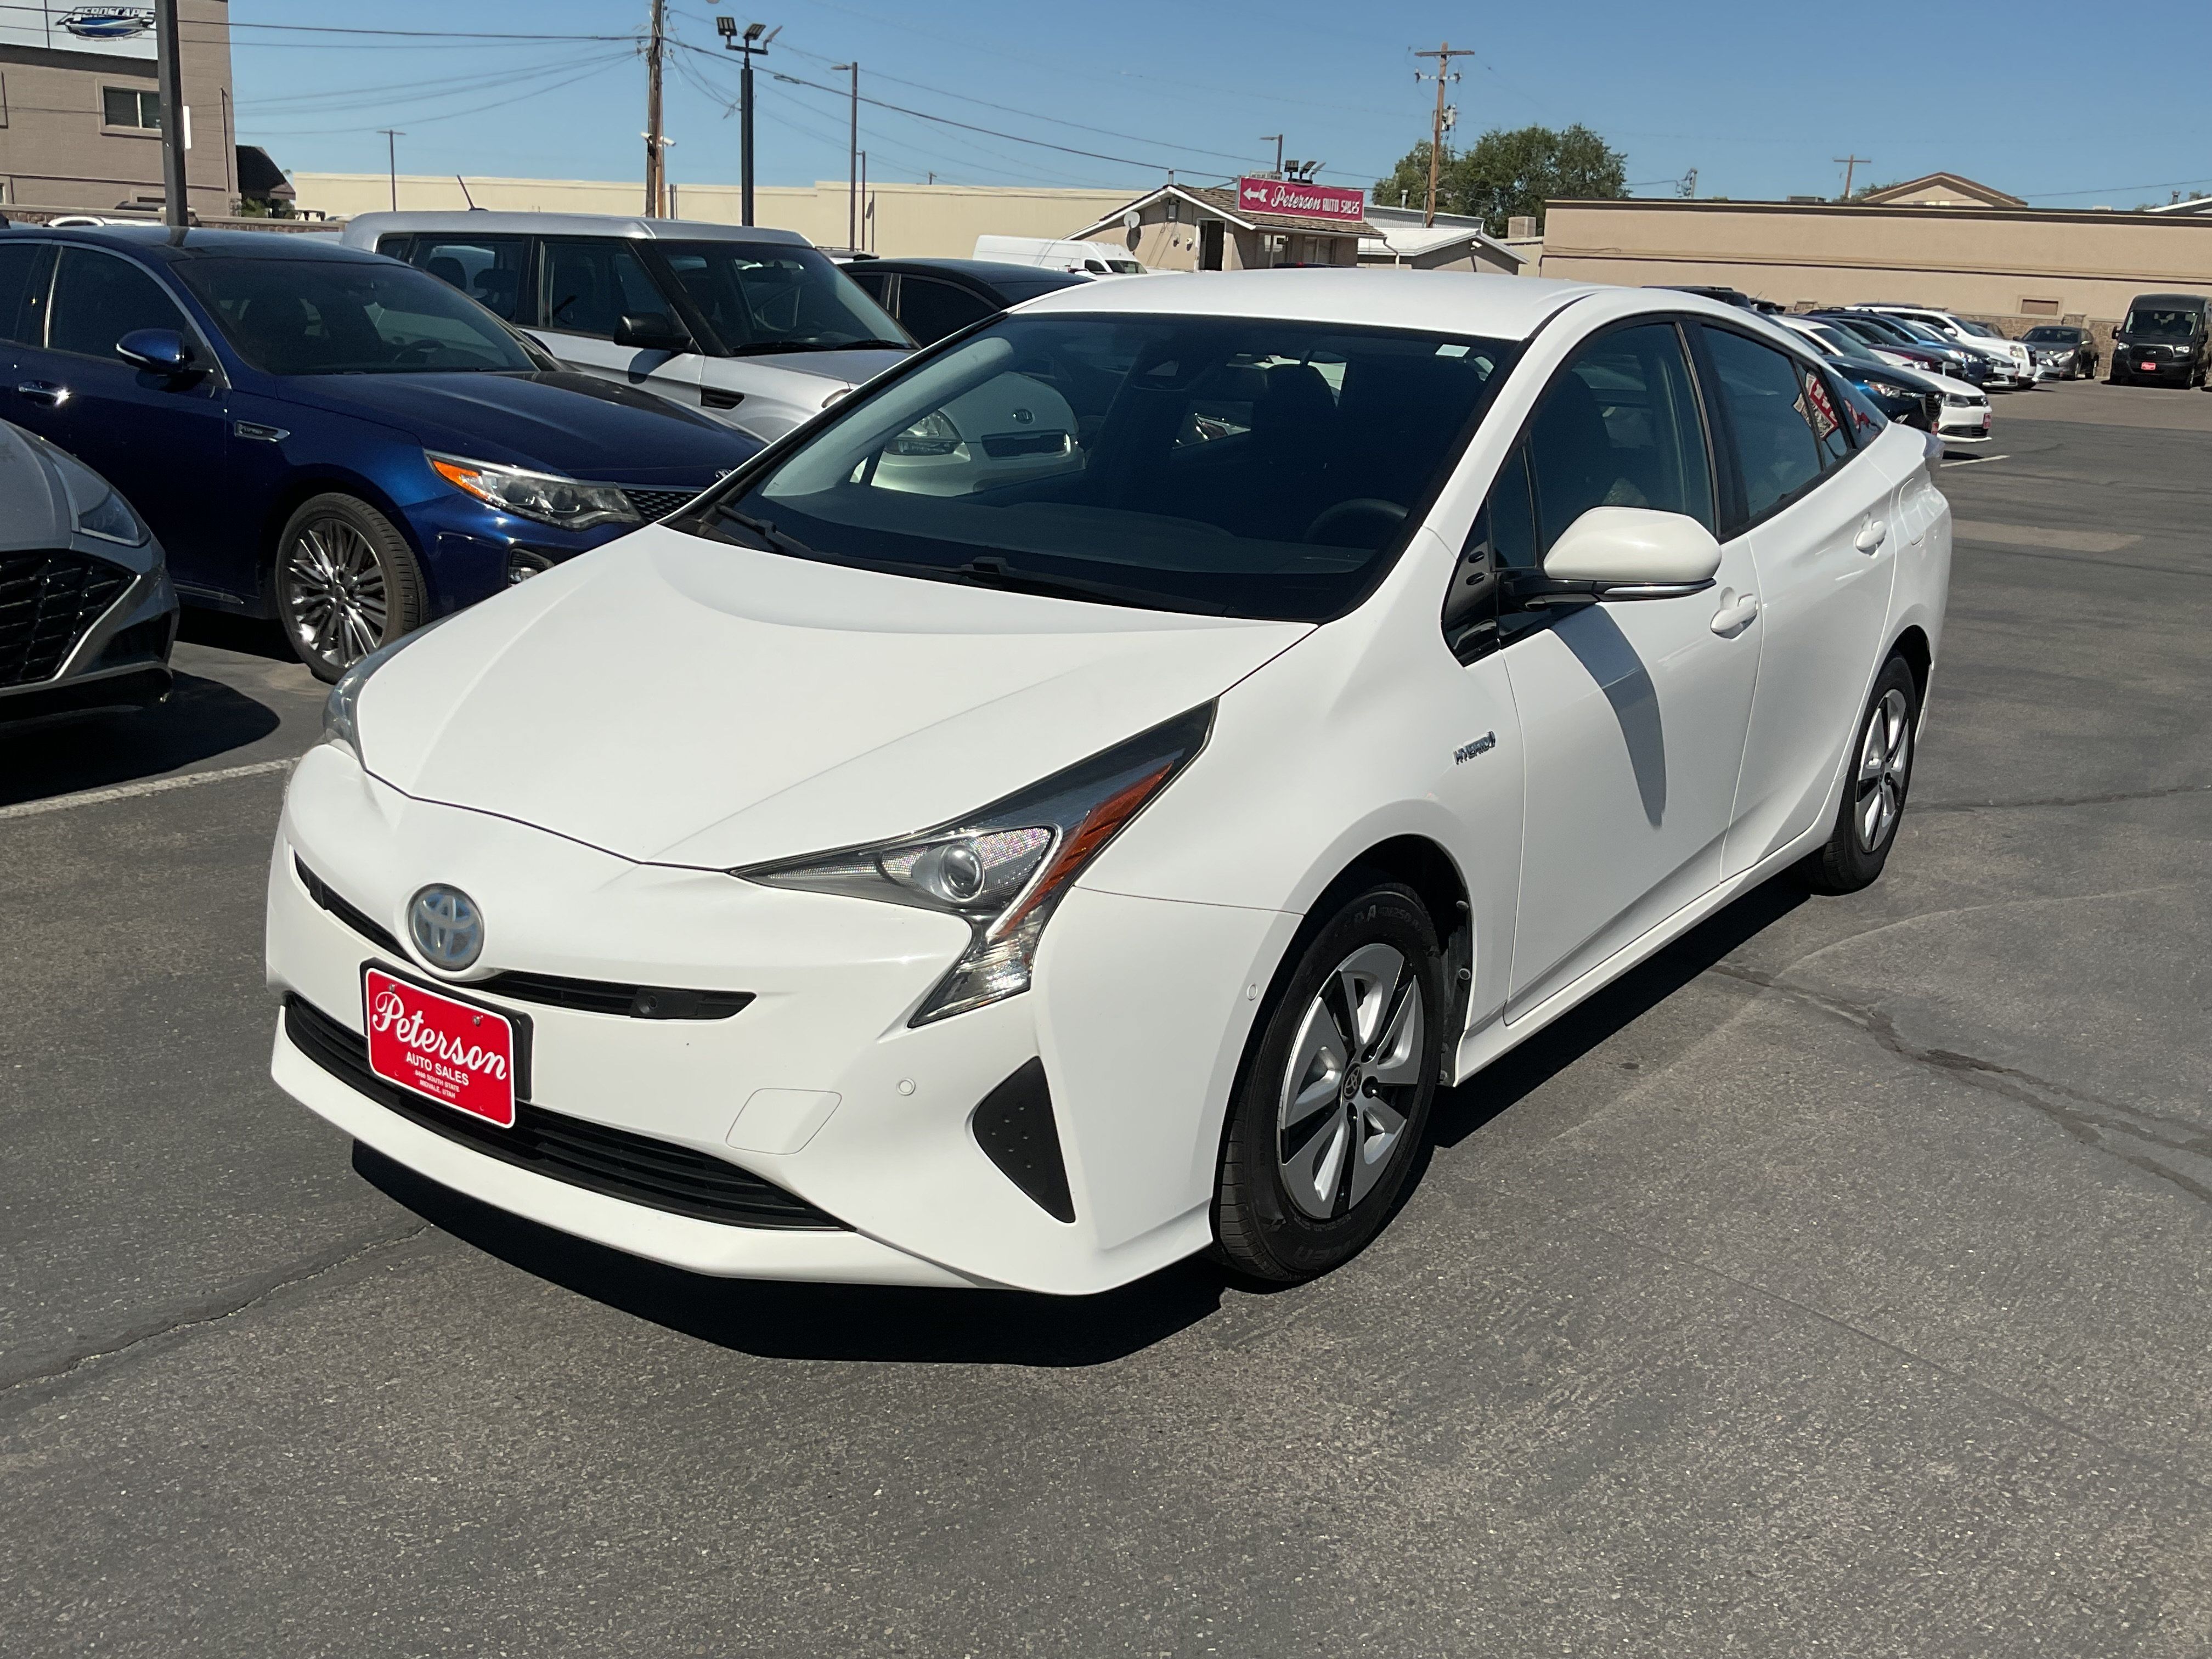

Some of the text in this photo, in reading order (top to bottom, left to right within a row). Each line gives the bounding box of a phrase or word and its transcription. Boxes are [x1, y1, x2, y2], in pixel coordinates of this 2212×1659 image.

[1271, 185, 1360, 215] Peterson AUTO SALES
[373, 991, 506, 1080] Peterson
[406, 1052, 469, 1086] AUTO SALES
[442, 1088, 455, 1099] UTAH
[444, 1081, 460, 1092] STATE
